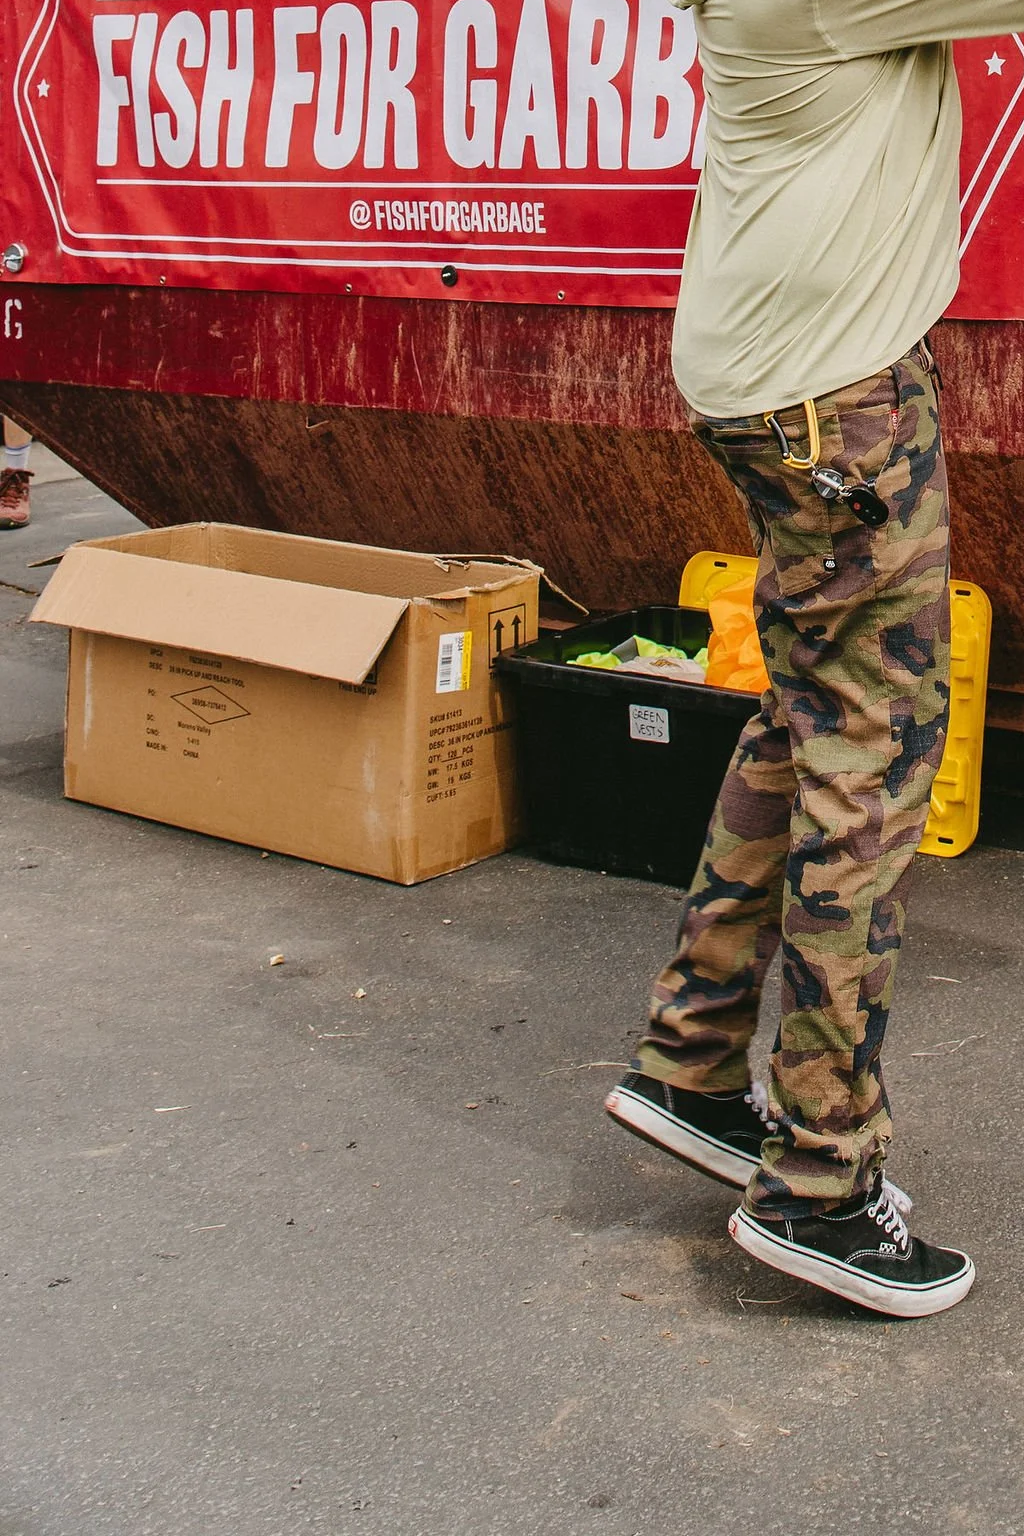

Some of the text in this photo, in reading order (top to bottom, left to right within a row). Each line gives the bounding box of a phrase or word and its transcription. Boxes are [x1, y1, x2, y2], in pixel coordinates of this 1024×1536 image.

[92, 8, 256, 170] FISH
[266, 0, 420, 170] FOR
[349, 199, 547, 234] @FISHFORGARBAGE
[182, 668, 194, 677] PICK
[632, 708, 664, 723] GREEN
[635, 722, 663, 737] VESTS
[428, 740, 445, 751] DESC
[462, 732, 475, 742] PICK
[475, 730, 484, 738] UP
[462, 745, 474, 755] PCS
[461, 758, 474, 768] KGS
[459, 772, 472, 782] KGS
